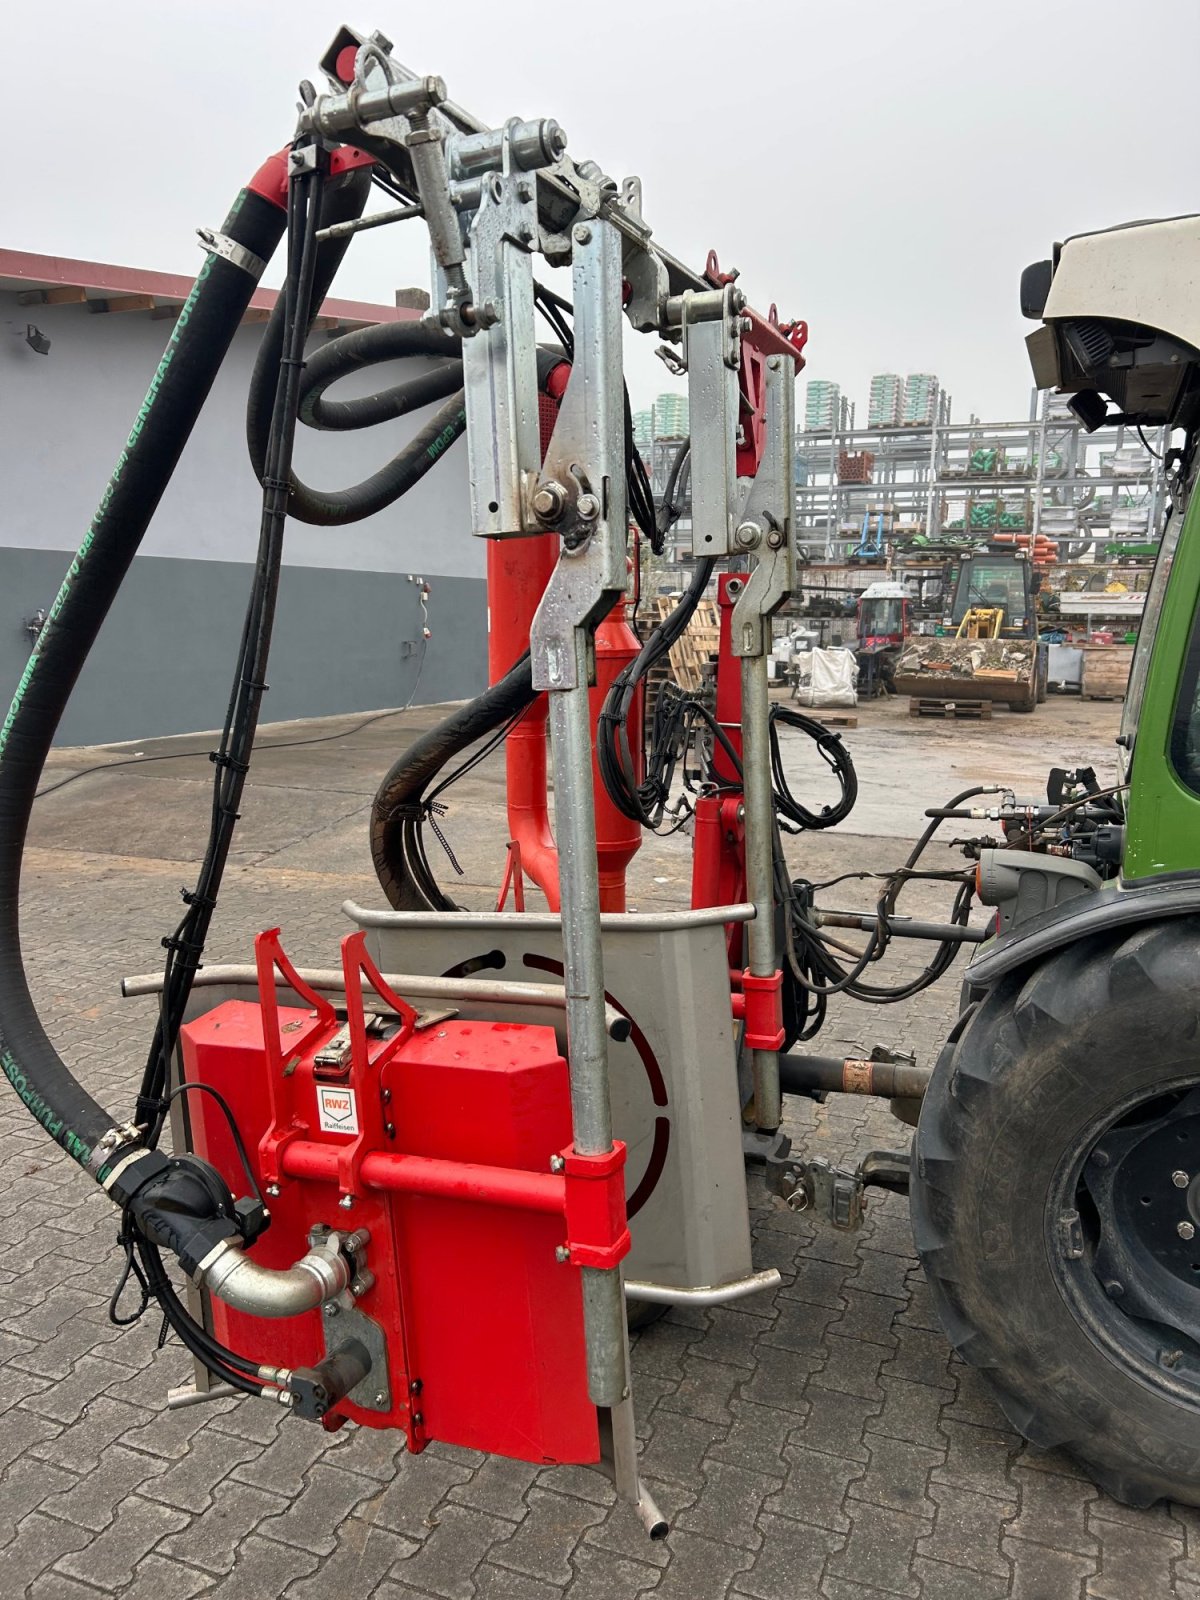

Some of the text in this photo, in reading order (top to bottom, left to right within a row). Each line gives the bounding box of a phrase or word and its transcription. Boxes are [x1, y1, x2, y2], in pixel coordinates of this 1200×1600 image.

[172, 252, 218, 343] PURPOS
[427, 425, 456, 458] EPDM
[325, 1098, 349, 1110] RWZ
[325, 1121, 355, 1131] Raiffeisen
